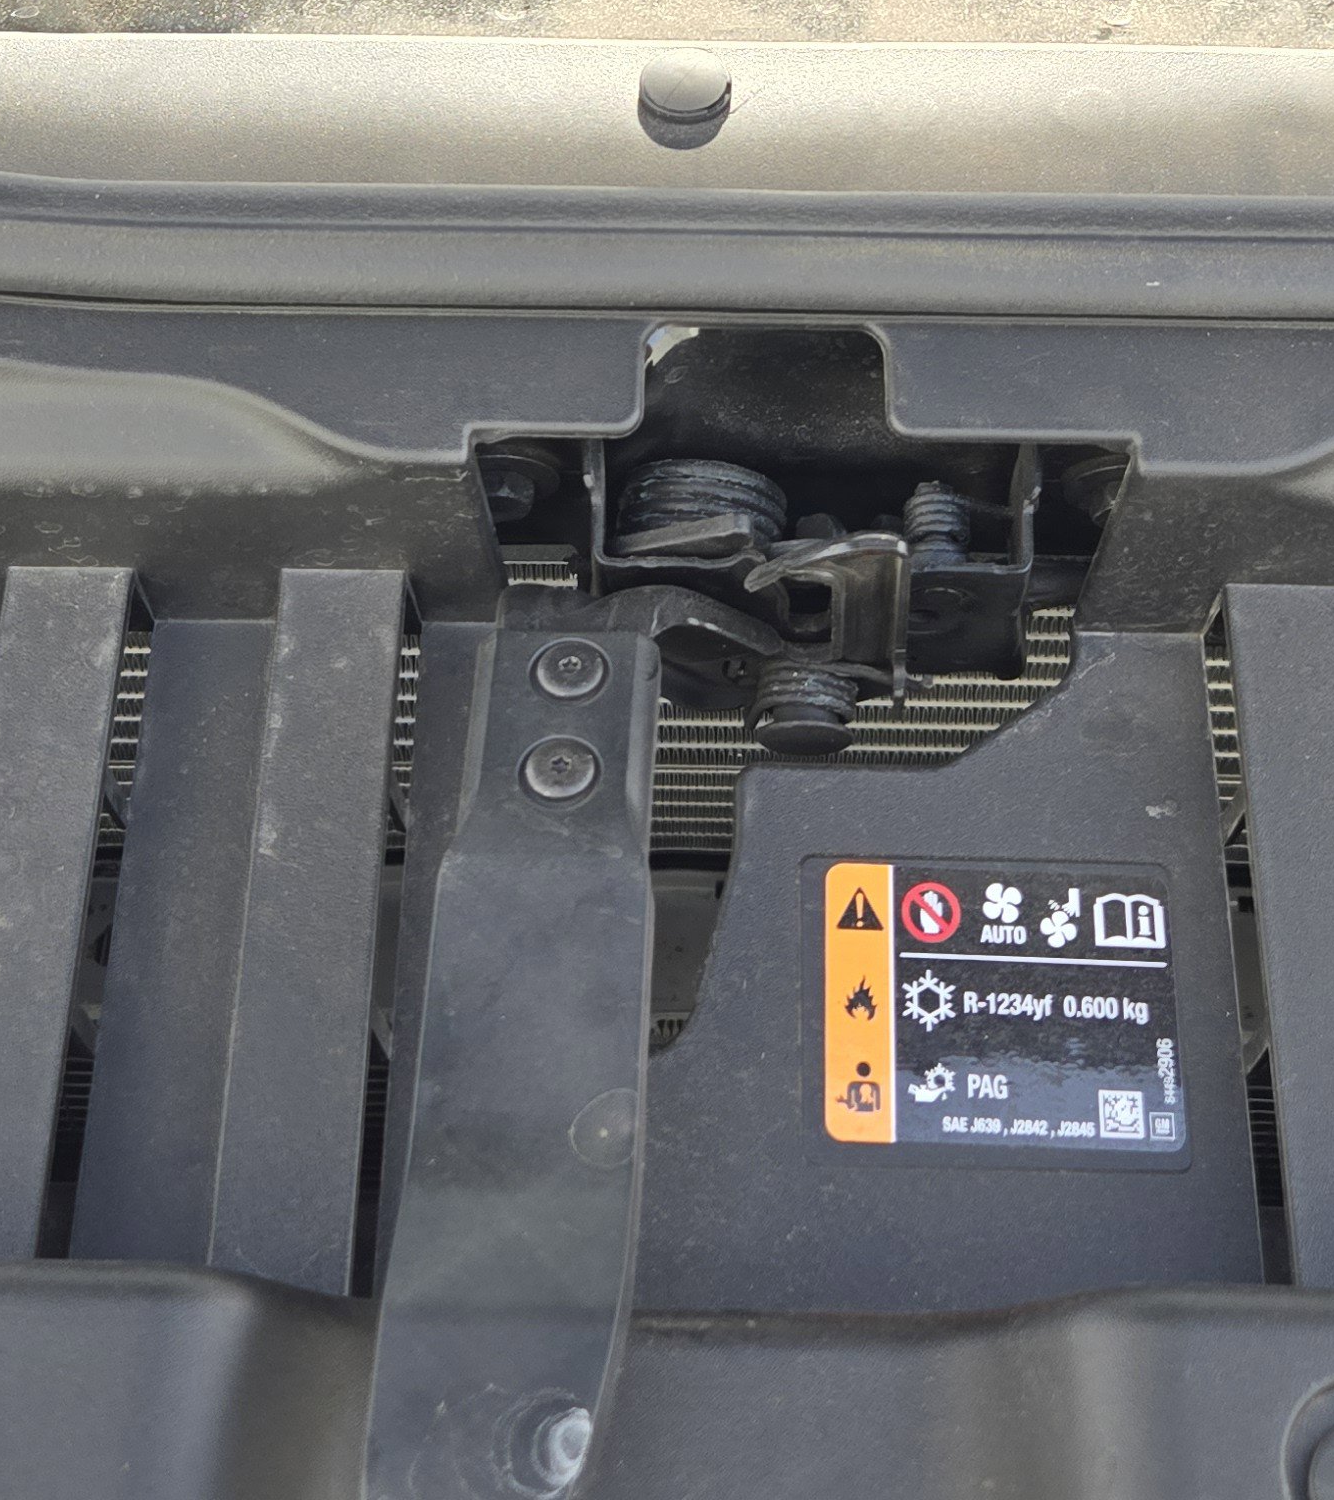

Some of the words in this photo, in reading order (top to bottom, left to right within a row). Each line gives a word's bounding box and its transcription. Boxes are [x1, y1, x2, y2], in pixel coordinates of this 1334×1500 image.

[980, 924, 1027, 946] AUTO
[962, 990, 1053, 1022] R-1234yf
[1063, 995, 1118, 1021] 0.600
[1122, 996, 1150, 1025] kg
[967, 1073, 1008, 1100] PAG
[941, 1115, 969, 1134] SAE
